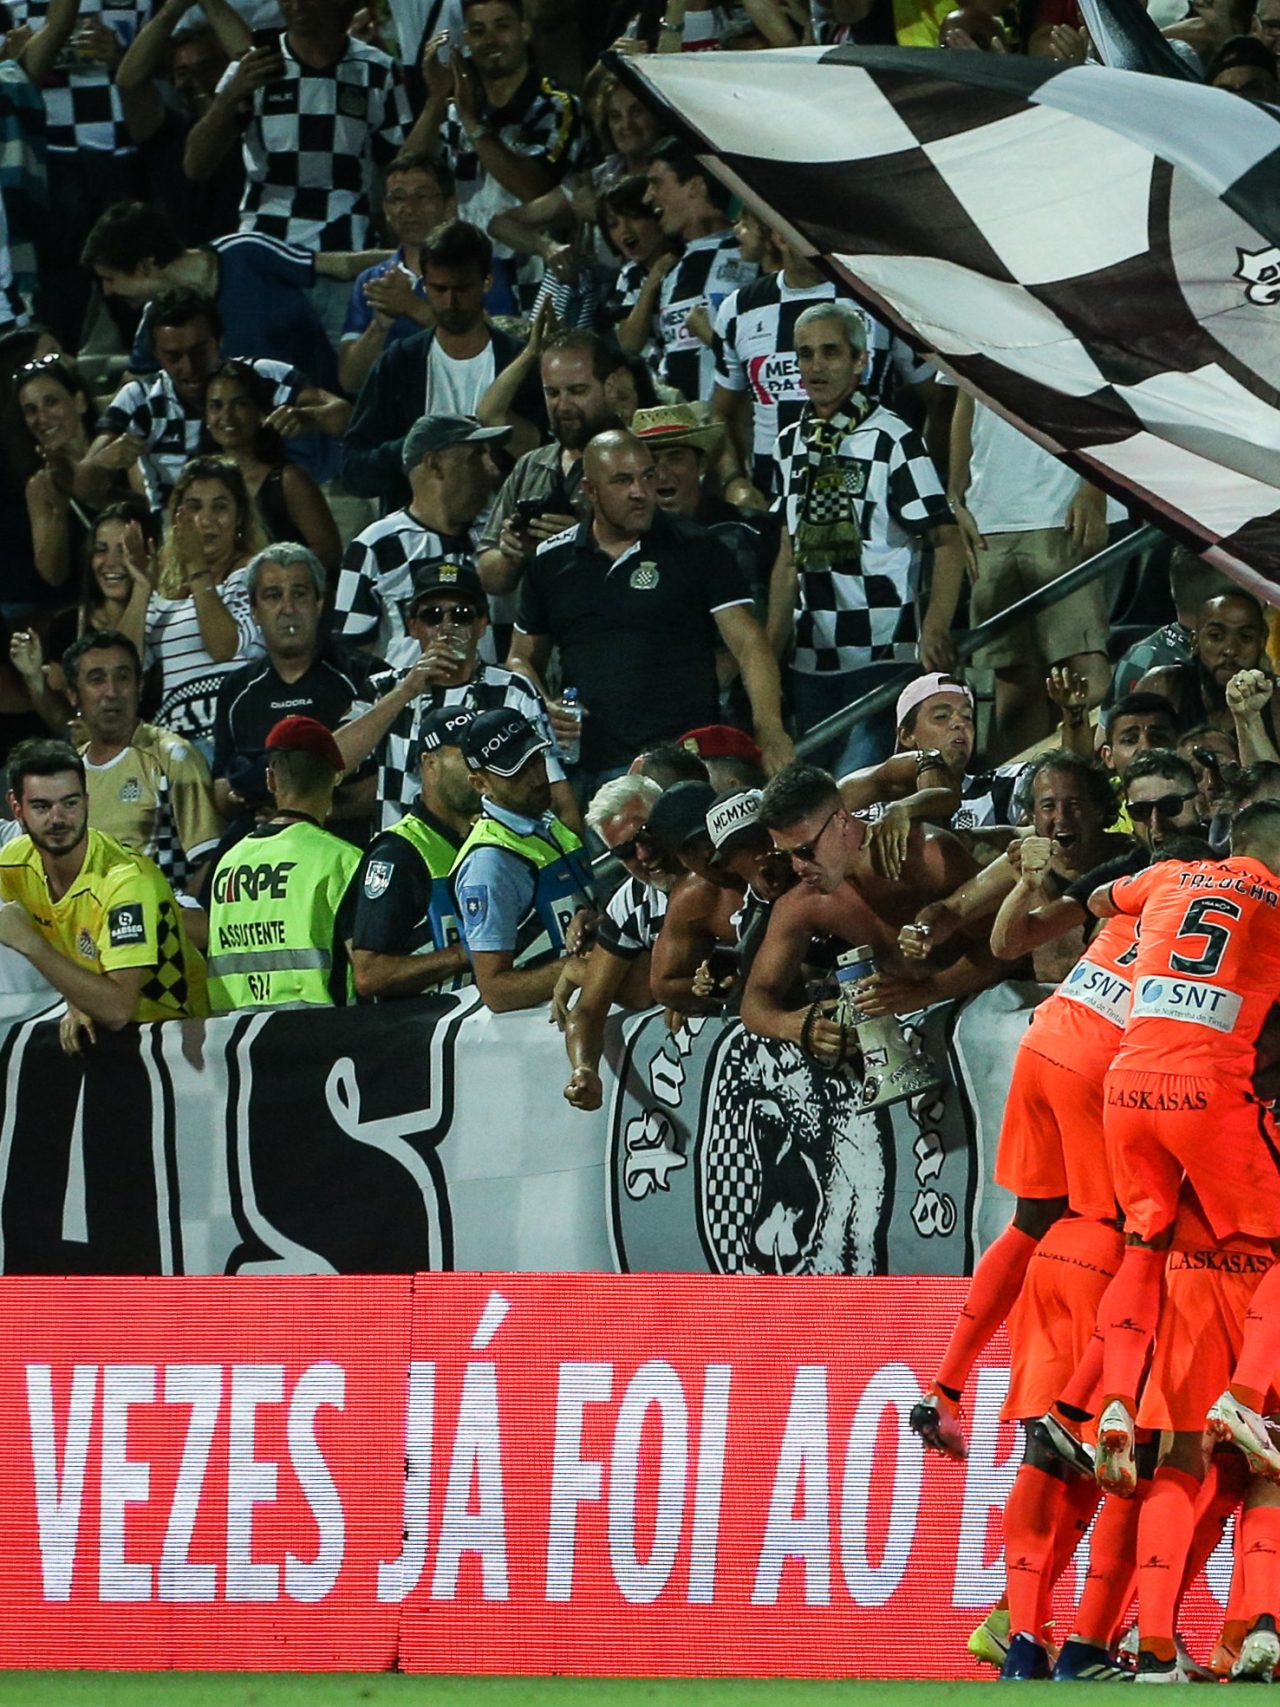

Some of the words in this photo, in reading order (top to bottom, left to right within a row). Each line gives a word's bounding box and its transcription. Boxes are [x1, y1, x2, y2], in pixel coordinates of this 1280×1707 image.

[270, 698, 313, 710] DIADORA
[1168, 895, 1243, 978] 5
[1083, 971, 1132, 1004] SNT
[1167, 983, 1227, 1012] SNT
[1107, 1085, 1209, 1112] LASKASAS
[25, 1360, 346, 1602] VEZES
[376, 1290, 511, 1602] JÁ
[545, 1359, 733, 1604] FOI
[751, 1363, 924, 1608] AO
